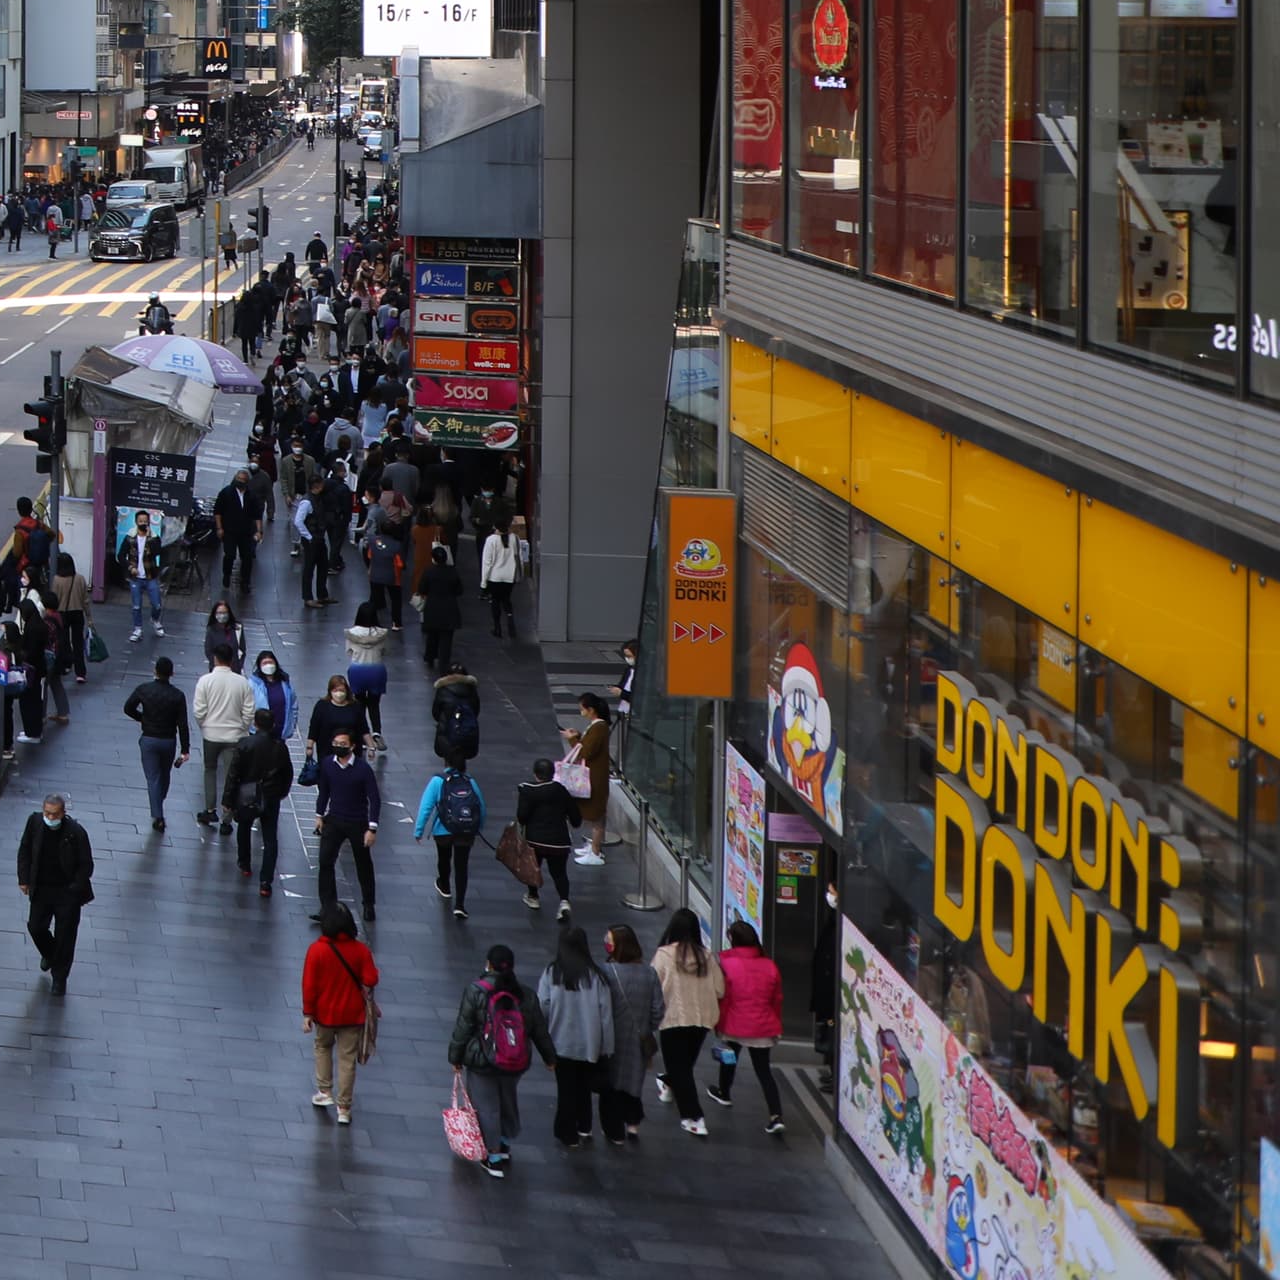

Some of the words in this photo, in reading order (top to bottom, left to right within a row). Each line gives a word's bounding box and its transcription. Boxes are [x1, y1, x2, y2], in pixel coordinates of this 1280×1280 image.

[377, 3, 412, 22] 15/F
[441, 3, 478, 22] 16/F
[474, 282, 495, 292] 8/F
[419, 312, 462, 323] GNC
[479, 346, 507, 360] 惠康
[419, 357, 460, 367] mannings
[473, 360, 511, 369] wellcome
[115, 462, 189, 482] 日本語学習
[675, 579, 698, 588] DON
[675, 588, 726, 602] DONKI
[936, 672, 1028, 832] DON
[934, 773, 1178, 1149] DONKI
